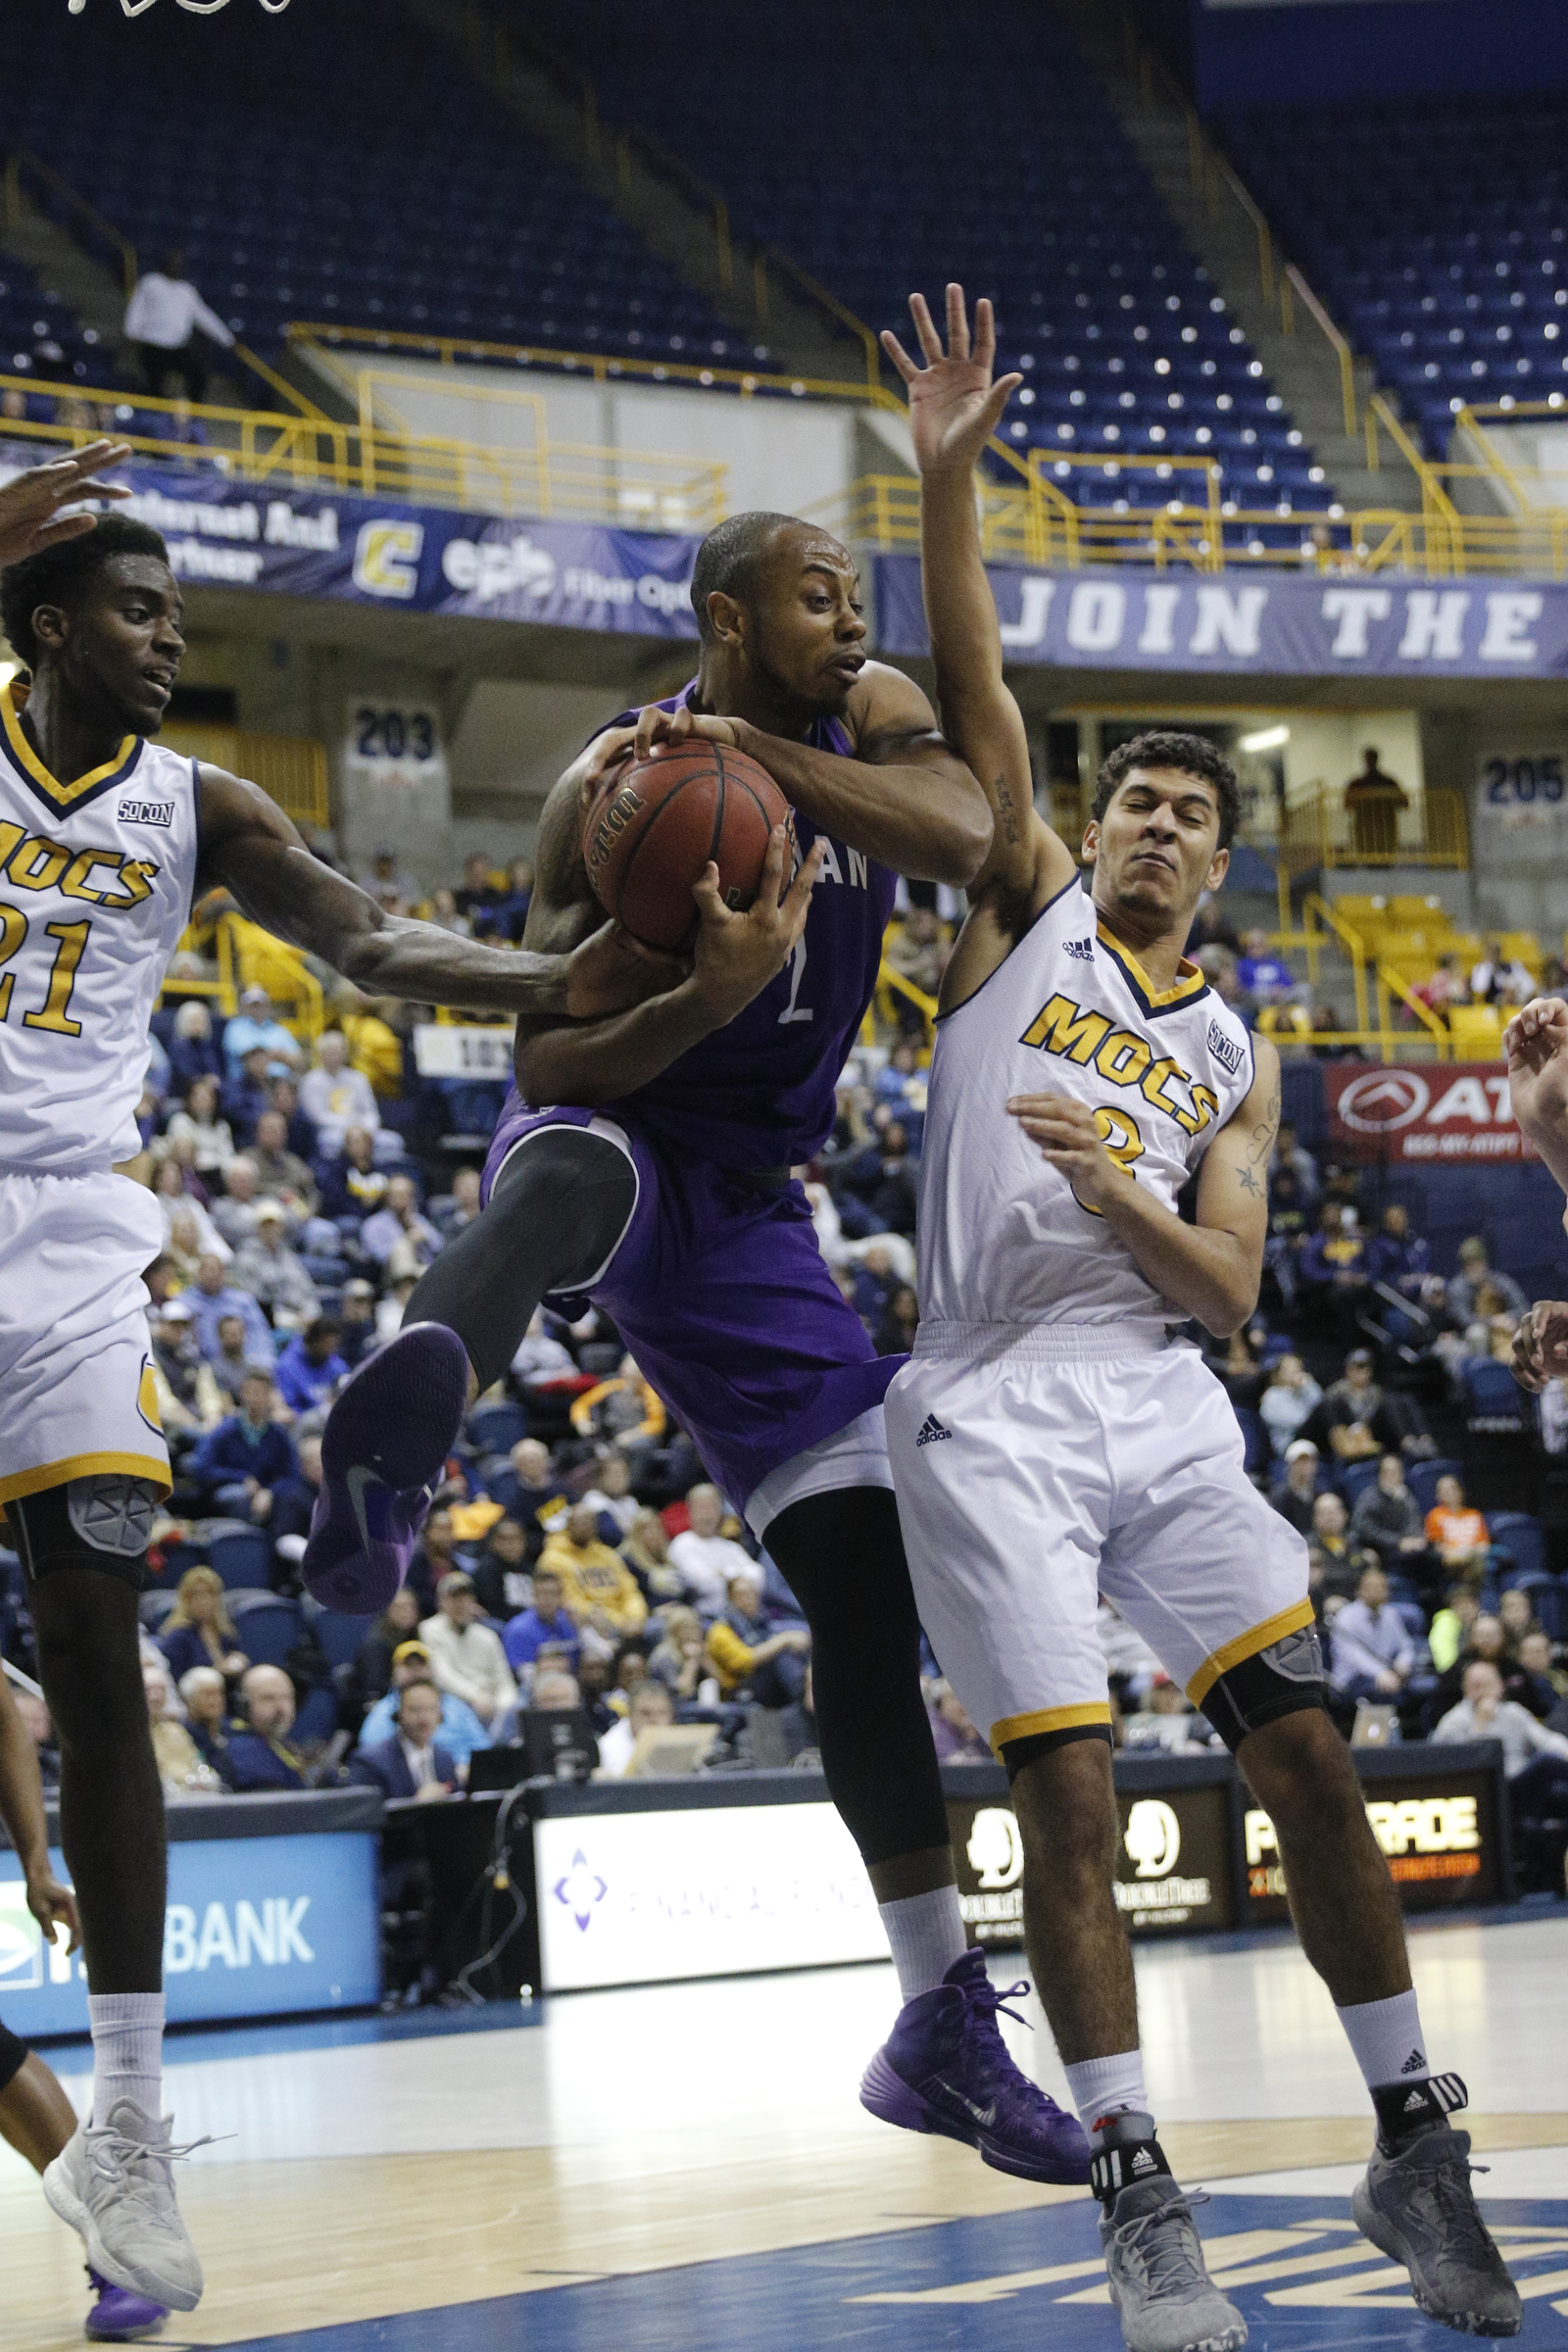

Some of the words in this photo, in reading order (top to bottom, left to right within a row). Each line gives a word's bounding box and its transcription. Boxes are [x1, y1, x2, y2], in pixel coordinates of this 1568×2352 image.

[1001, 577, 1267, 656] JOIN
[1321, 588, 1544, 662] THE
[356, 705, 433, 761] 203
[1486, 756, 1564, 804] 205
[1062, 942, 1095, 962] adidas
[1018, 992, 1219, 1139] MOCS
[915, 1429, 953, 1447] adidas
[165, 1895, 315, 1974] BANK
